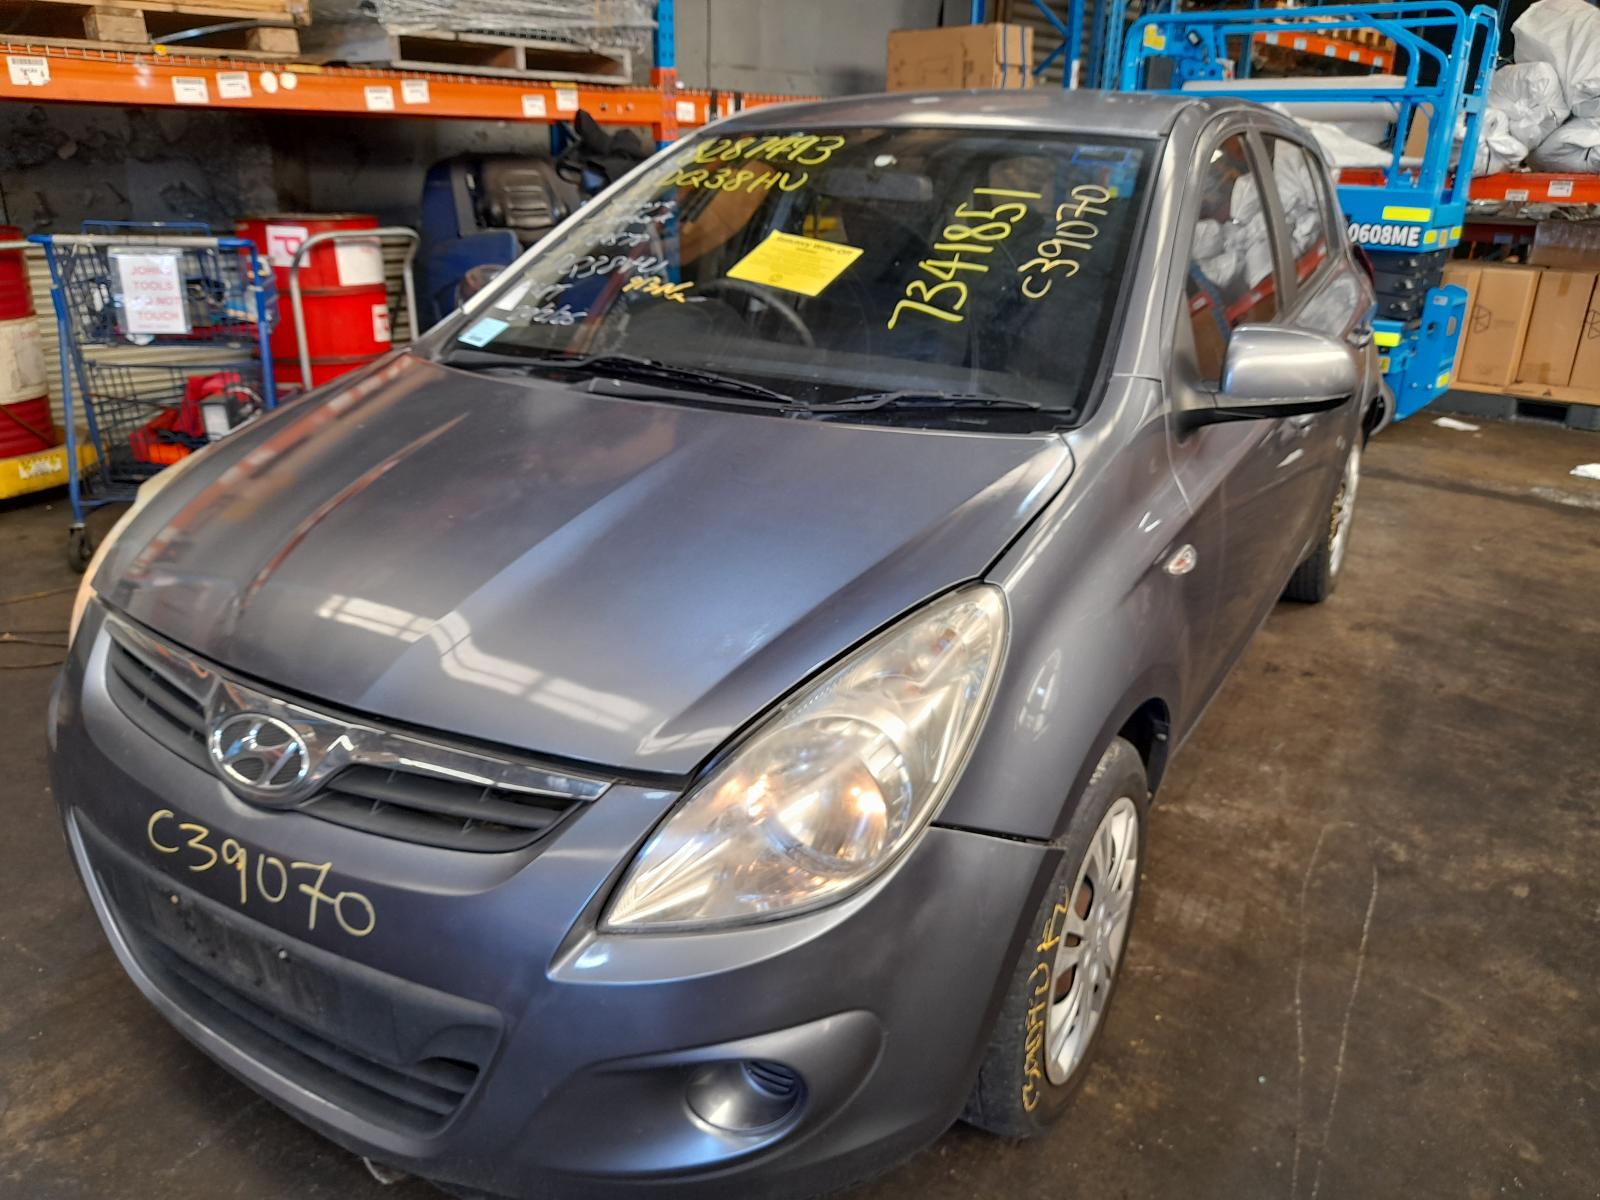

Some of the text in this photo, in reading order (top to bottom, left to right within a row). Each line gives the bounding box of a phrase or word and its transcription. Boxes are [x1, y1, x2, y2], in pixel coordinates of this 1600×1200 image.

[887, 187, 1042, 330] 7341851
[1017, 184, 1111, 299] C39070
[147, 808, 376, 936] C39070
